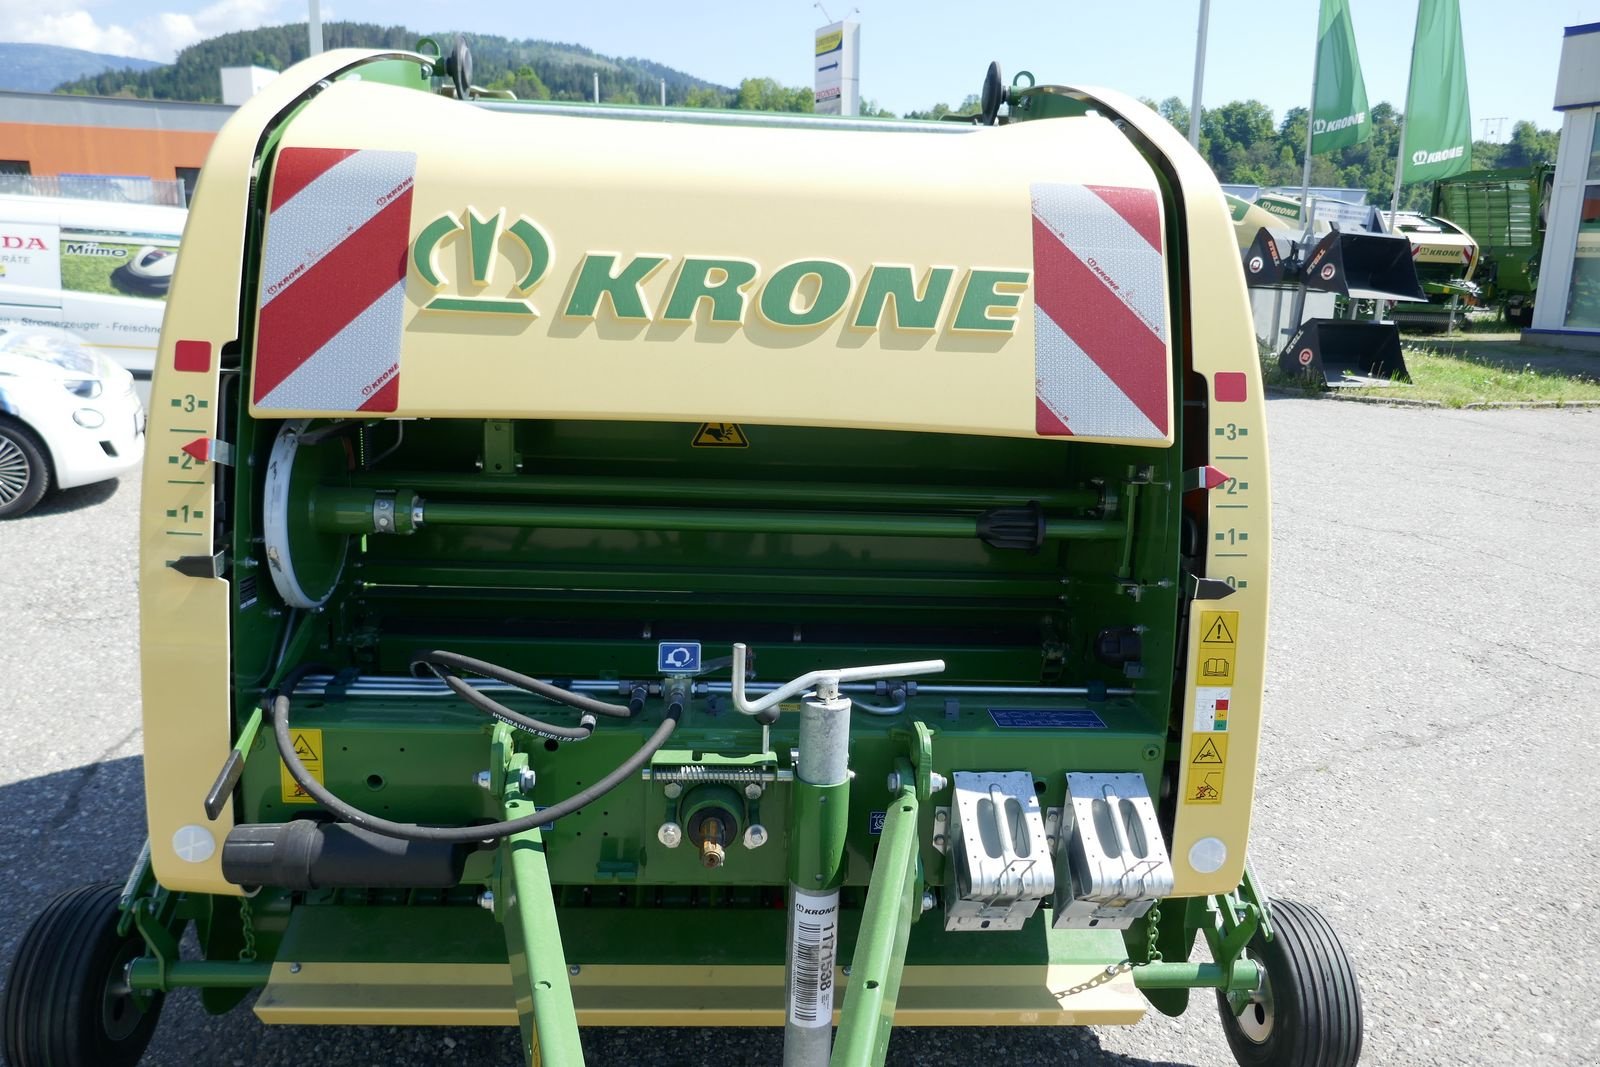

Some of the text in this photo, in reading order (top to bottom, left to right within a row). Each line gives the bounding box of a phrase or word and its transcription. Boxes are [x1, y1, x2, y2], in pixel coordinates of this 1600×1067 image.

[1326, 112, 1366, 132] KRONE
[1427, 146, 1464, 164] KRONE
[386, 176, 414, 200] KRONE
[1269, 205, 1298, 217] KRONE
[66, 242, 128, 257] Miimo
[1429, 249, 1461, 257] KRONE
[277, 263, 306, 289] KRONE
[1093, 266, 1120, 291] KRONE
[563, 251, 1033, 335] KRONE
[371, 362, 400, 389] KRONE
[184, 394, 196, 413] 3
[1226, 423, 1237, 441] 3
[181, 452, 193, 470] 2
[1226, 477, 1237, 495] 2
[181, 504, 190, 523] 1
[1227, 528, 1236, 545] 1
[492, 711, 537, 735] HYDRAULIK
[804, 904, 836, 916] KRONE
[820, 922, 835, 992] 1171538
